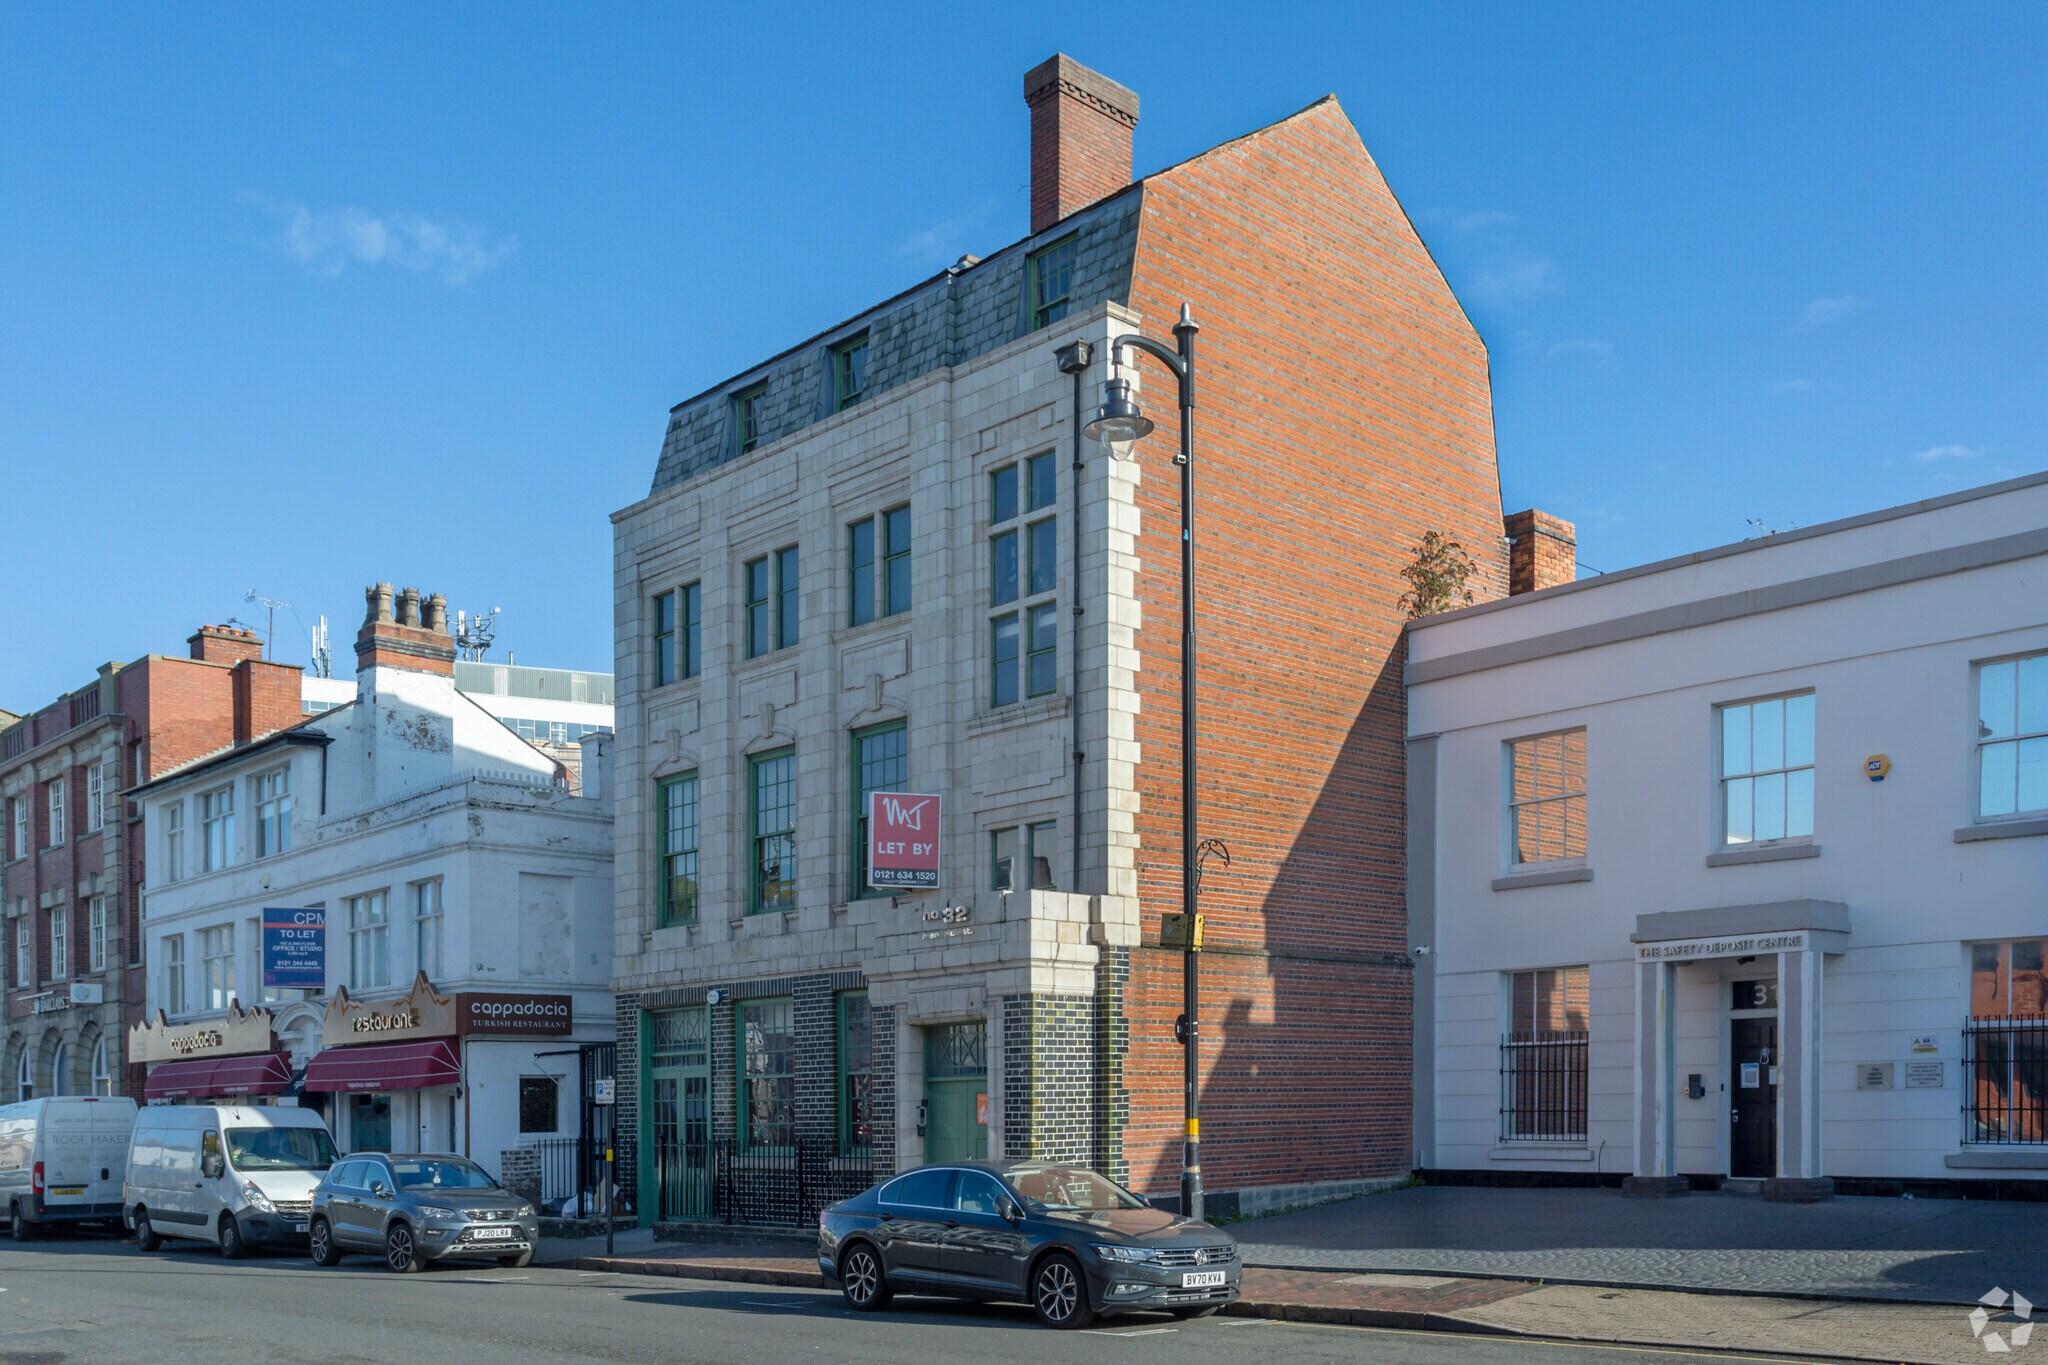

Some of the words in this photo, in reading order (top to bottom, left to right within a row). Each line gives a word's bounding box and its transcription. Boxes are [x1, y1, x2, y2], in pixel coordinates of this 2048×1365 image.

[878, 842, 906, 855] LET
[912, 843, 933, 855] BY
[874, 870, 895, 879] 0121
[897, 871, 913, 880] 634
[915, 871, 936, 881] 1520
[943, 905, 968, 923] 32
[280, 930, 295, 939] TO
[297, 930, 316, 939] LET
[1639, 946, 1661, 958] THE
[1663, 944, 1702, 957] SAFETY
[1706, 940, 1754, 953] DEPOSIT
[1757, 936, 1802, 949] CENTRE
[471, 1000, 568, 1018] cappadocia
[352, 1008, 413, 1032] restaurant
[472, 1019, 511, 1027] TURKISH
[513, 1020, 567, 1029] RESTAURANT
[52, 1135, 87, 1145] ROOF
[91, 1134, 131, 1144] MAKER
[477, 1229, 495, 1237] PJ20
[1187, 1274, 1207, 1285] BV70
[1208, 1273, 1222, 1283] KVA
